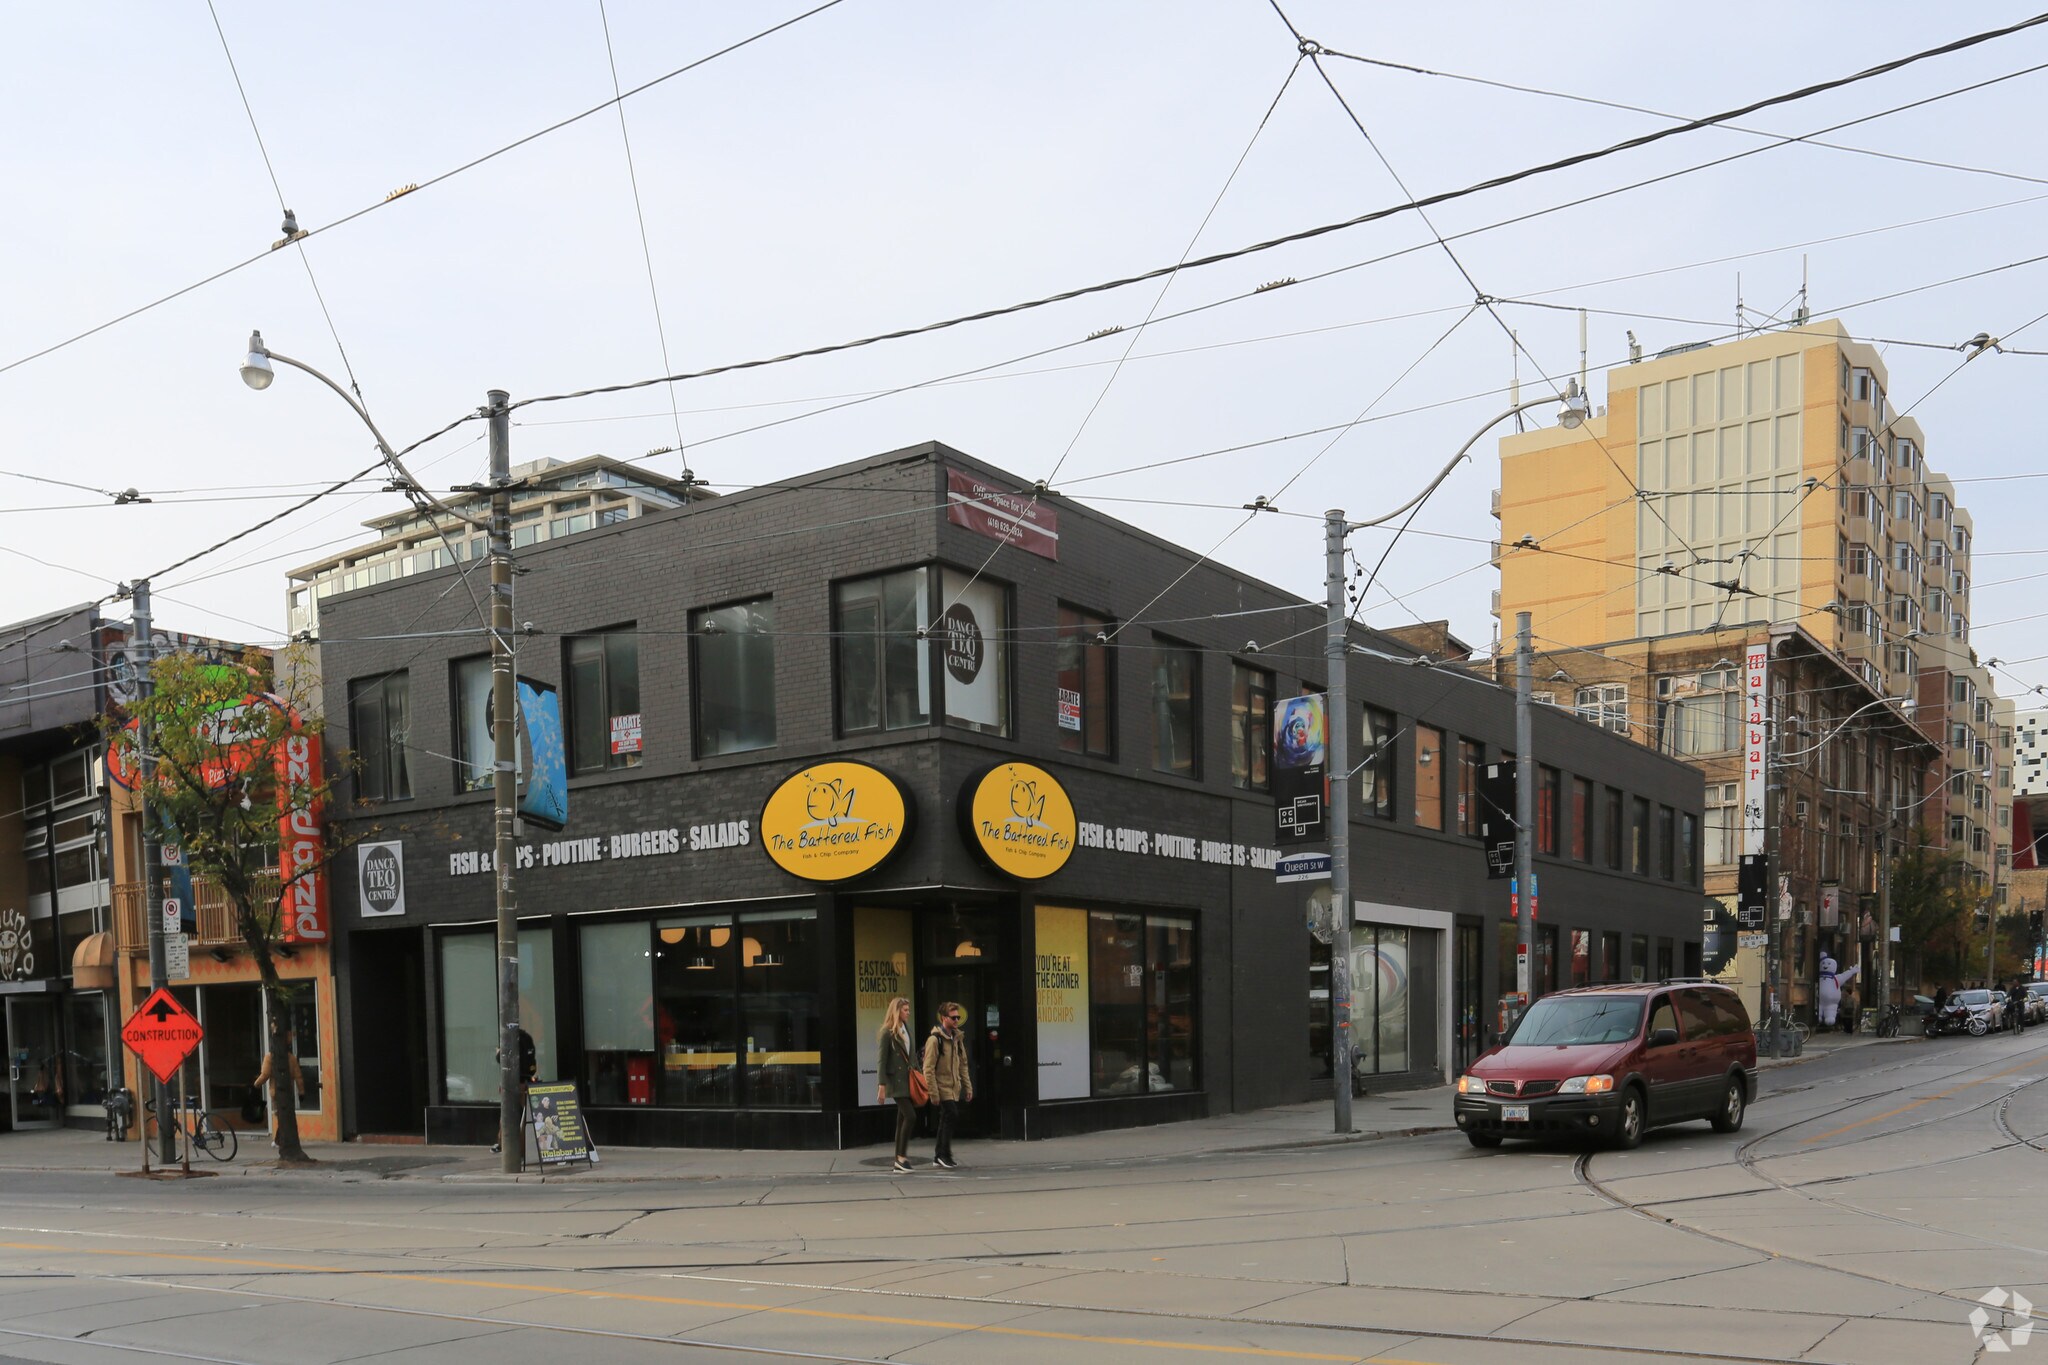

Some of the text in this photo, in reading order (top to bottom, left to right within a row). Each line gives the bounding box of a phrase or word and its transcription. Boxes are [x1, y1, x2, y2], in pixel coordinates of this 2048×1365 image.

[993, 494, 1010, 509] Space
[1011, 499, 1020, 512] for
[948, 617, 976, 637] DANCE
[947, 631, 976, 660] TEQ
[948, 654, 976, 672] CENTRE
[1058, 689, 1079, 707] ARATE
[613, 714, 641, 731] KARATE
[1748, 653, 1766, 780] Malabar
[772, 822, 895, 850] The Battered Fish
[982, 821, 1070, 850] The Battered Fish
[1078, 821, 1104, 849] FISH
[1106, 829, 1115, 850] &
[1116, 827, 1149, 855] CHIPS
[1155, 833, 1196, 861] POUTINE
[450, 820, 750, 876] FISH & CPS POUTINE BURGERS SALADS
[834, 849, 860, 857] Company
[367, 857, 396, 871] DANCE
[1284, 860, 1324, 873] Queen St W
[367, 869, 397, 890] TEQ
[292, 841, 326, 939] pizza
[368, 889, 397, 901] CENTRE
[858, 960, 906, 977] EAST COAST
[1036, 954, 1071, 972] YOU'RE AT
[859, 977, 898, 993] COMES TO
[1036, 972, 1080, 989] THE CORNER
[860, 993, 885, 1009] QUEEN
[1046, 989, 1063, 1005] FISH
[1037, 1006, 1074, 1023] AND CHIPS
[126, 1029, 199, 1042] CONSTRUCTION
